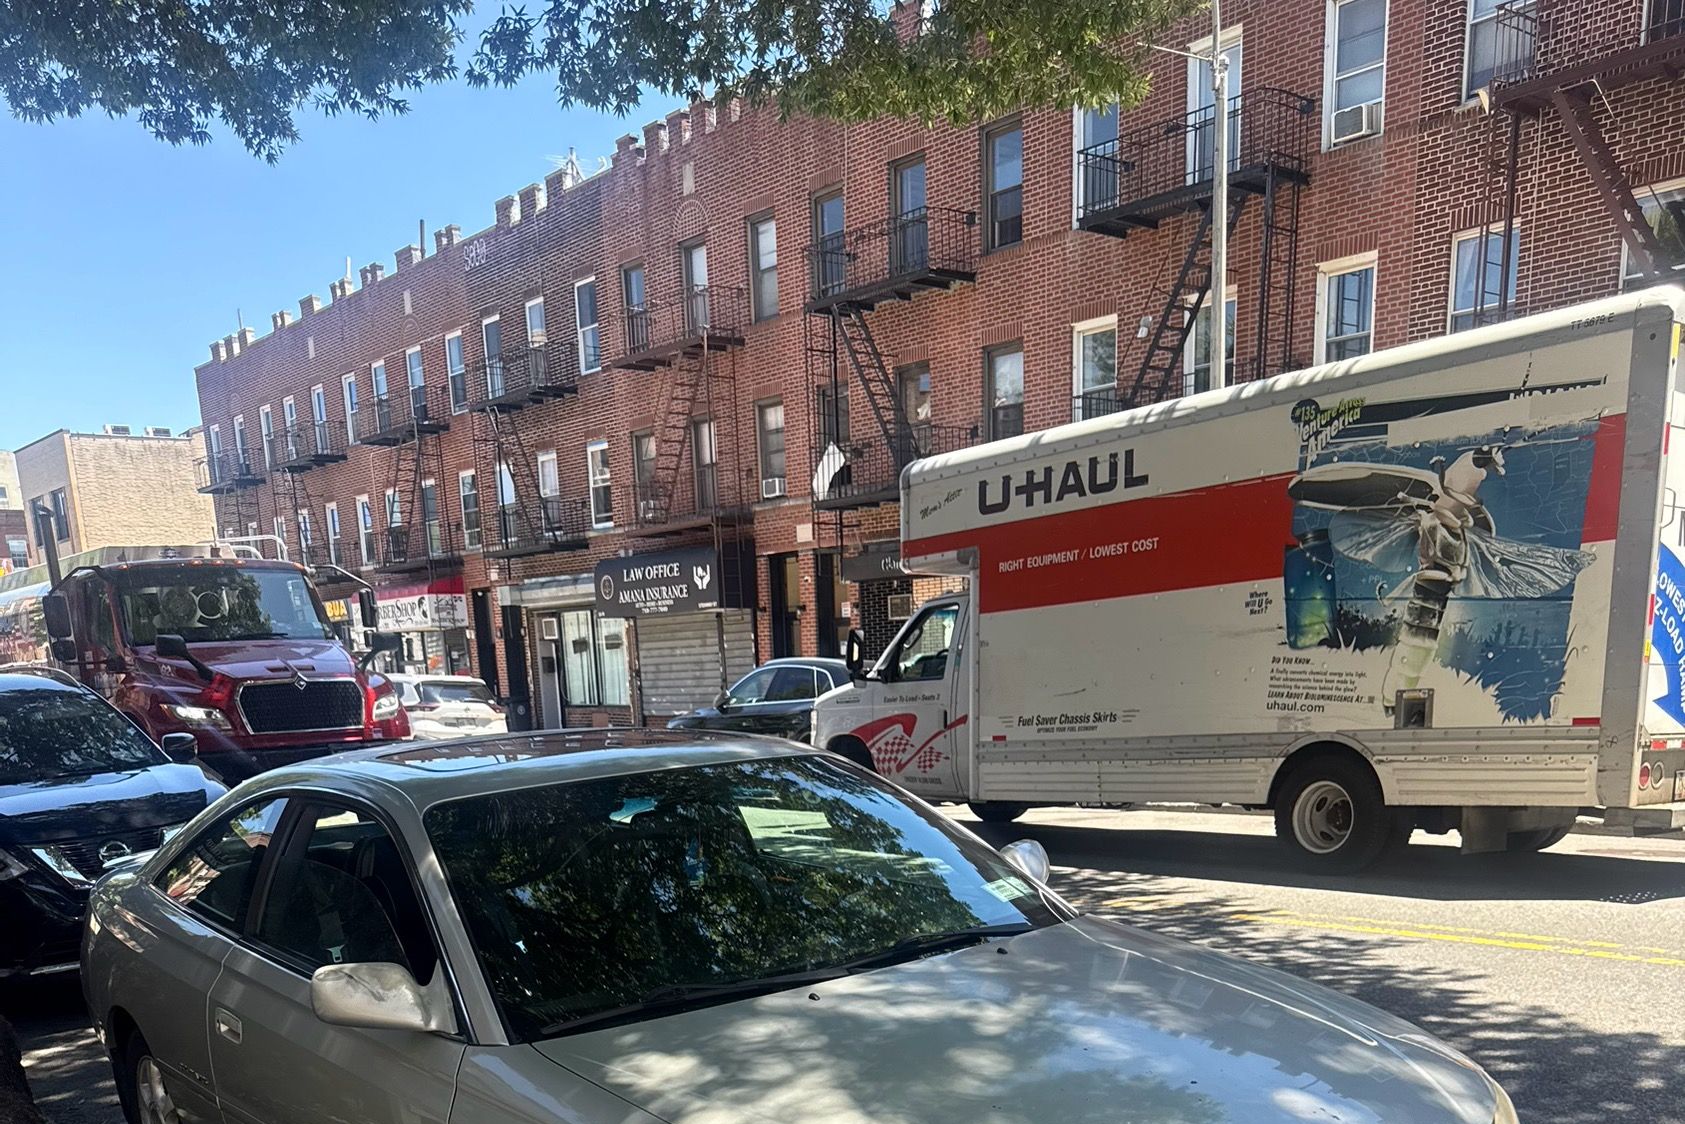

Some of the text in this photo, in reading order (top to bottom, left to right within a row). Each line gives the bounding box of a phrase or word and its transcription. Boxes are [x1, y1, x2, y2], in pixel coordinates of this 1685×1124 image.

[1305, 408, 1361, 462] America
[978, 448, 1150, 516] U-HAUL
[998, 558, 1025, 573] RIGHT
[1027, 549, 1080, 569] EQUIPMENT
[1089, 542, 1129, 559] LOWEST
[1131, 537, 1160, 553] COST
[622, 562, 681, 582] LAW OFFICE
[619, 584, 688, 604] AMANA INSURANCE
[1266, 700, 1325, 713] uhaul.com
[1017, 711, 1118, 727] Fuel Saver Chassis Skirts
